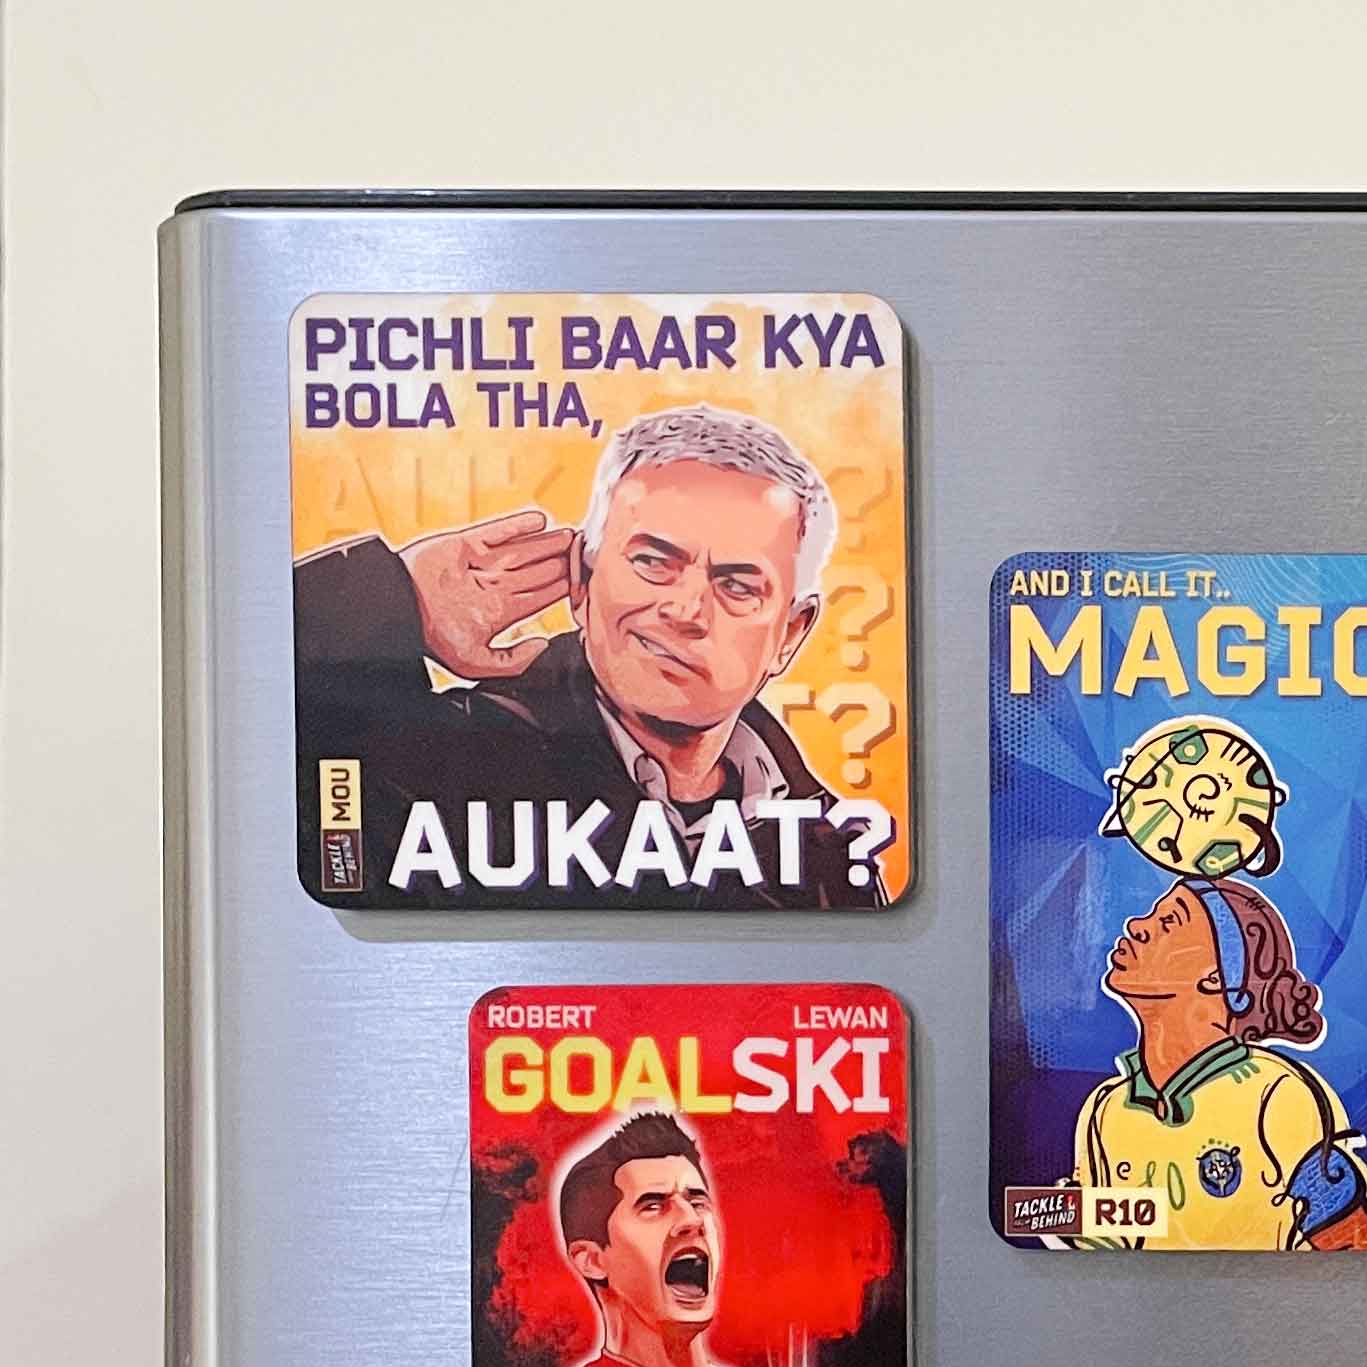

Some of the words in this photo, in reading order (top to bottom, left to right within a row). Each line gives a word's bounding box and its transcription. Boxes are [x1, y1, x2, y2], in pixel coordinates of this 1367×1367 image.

[305, 316, 534, 372] PICHLI
[561, 315, 737, 370] BAAR
[763, 313, 885, 368] KYA
[304, 382, 455, 429] BOLA
[477, 382, 603, 438] THA,
[1010, 570, 1070, 596] AND
[1080, 570, 1094, 596] I
[1103, 571, 1176, 597] CALL
[330, 768, 351, 822] MOU
[388, 800, 897, 891] AUKAAT?
[487, 1006, 596, 1029] ROBERT
[793, 1005, 888, 1029] LEWAN
[484, 1036, 891, 1114] GOALSKI
[1014, 1194, 1064, 1218] TACKLE
[1030, 1210, 1076, 1231] BEHIND
[1095, 1199, 1156, 1226] R10
